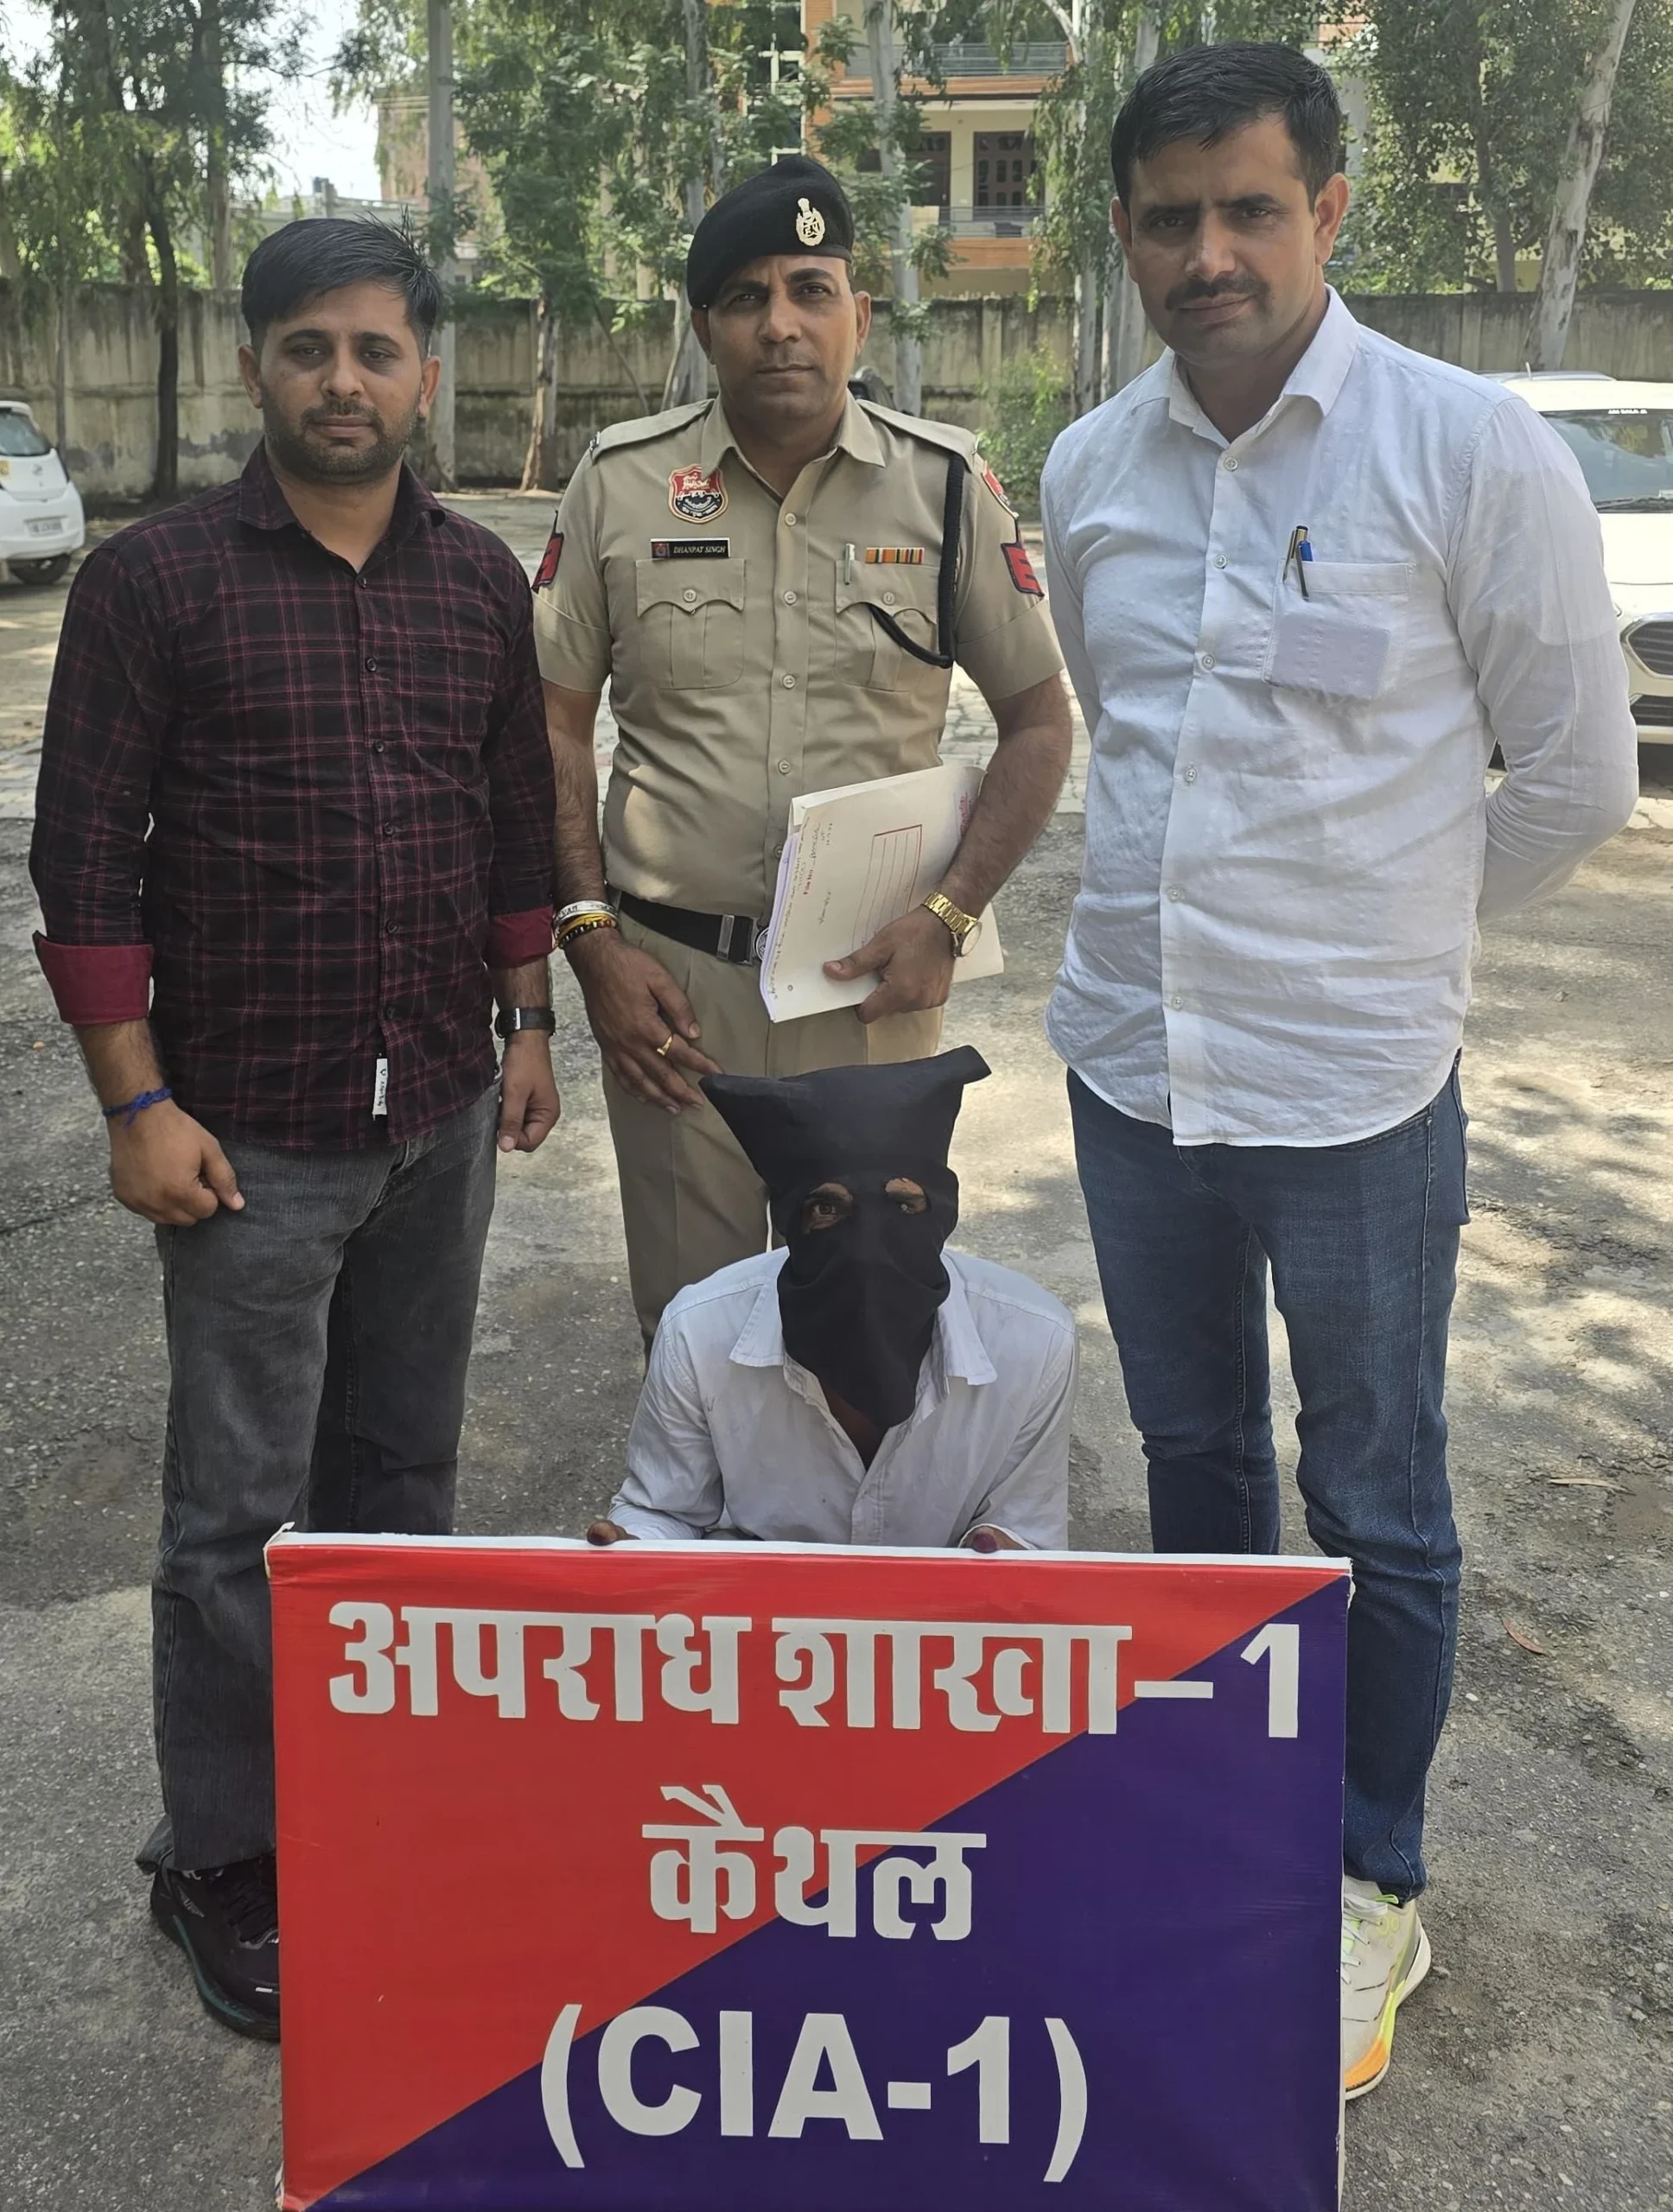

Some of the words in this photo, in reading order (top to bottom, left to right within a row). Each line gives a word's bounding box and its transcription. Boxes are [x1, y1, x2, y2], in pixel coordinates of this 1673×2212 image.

[673, 545, 704, 554] DHANPAT
[704, 545, 726, 554] SINGH
[329, 1601, 753, 1725] अपराध
[642, 1784, 987, 1941] कैथल
[540, 2004, 1088, 2183] (CIA-1)
